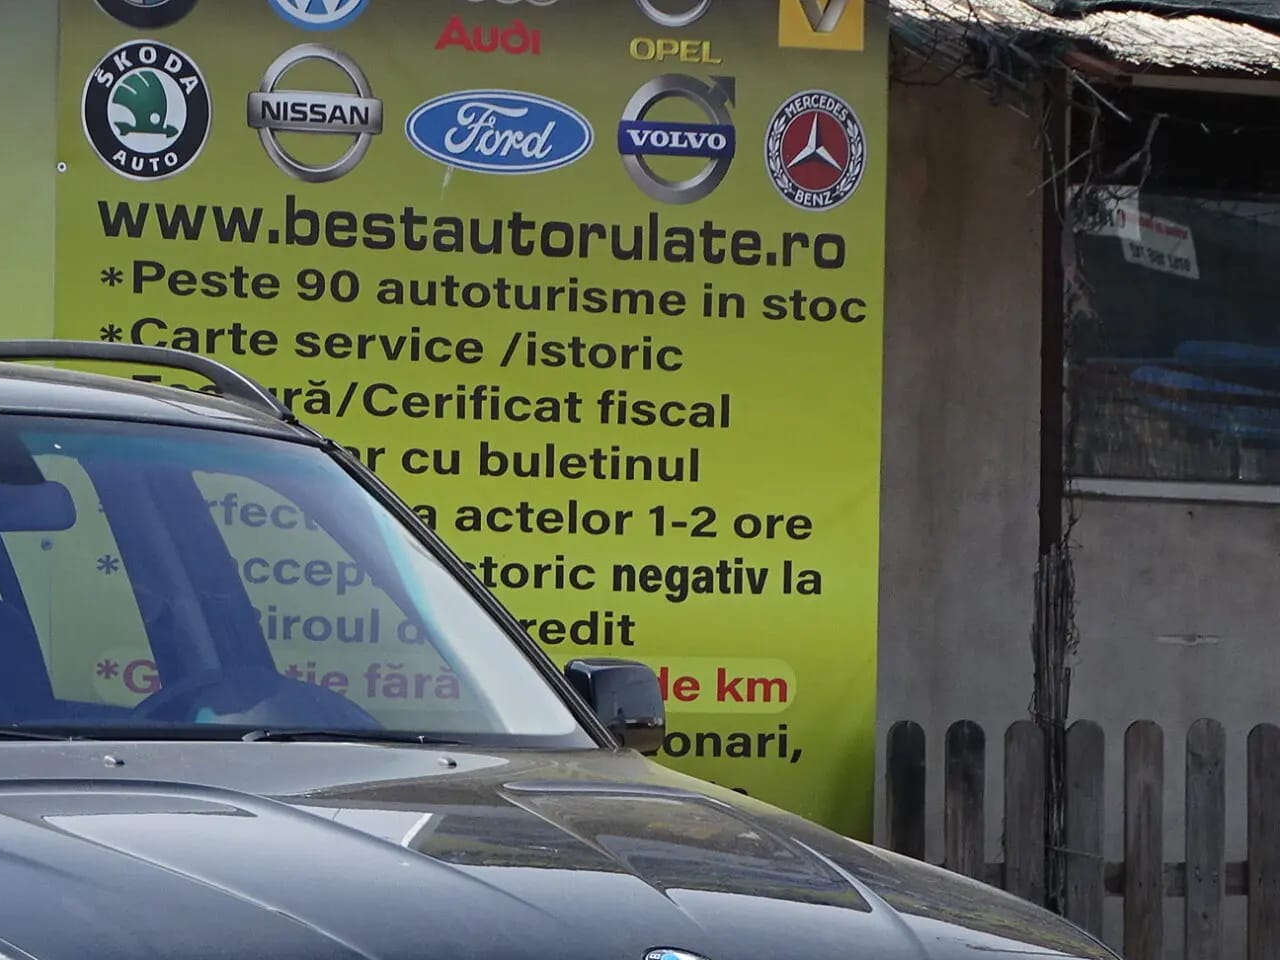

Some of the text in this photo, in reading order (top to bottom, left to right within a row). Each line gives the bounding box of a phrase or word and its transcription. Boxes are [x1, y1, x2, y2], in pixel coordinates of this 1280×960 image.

[434, 15, 542, 56] Audi
[629, 37, 723, 65] OPEL
[261, 100, 369, 126] NISSAN
[783, 94, 850, 123] MERCEDES
[443, 101, 554, 160] Ford
[626, 128, 727, 151] VOLVO
[112, 149, 179, 173] AUTO
[793, 190, 834, 207] BENZ
[97, 194, 846, 270] www.bestautorulate.ro
[296, 268, 360, 302] 90
[377, 274, 687, 316] autoturisme
[703, 283, 746, 319] in
[762, 289, 867, 324] stoc
[294, 327, 483, 363] service
[597, 389, 731, 428] fiscal
[401, 447, 461, 475] cu
[479, 441, 700, 483] buletinul
[455, 501, 633, 536] actelor
[648, 505, 717, 538] 1-2
[733, 512, 813, 540] ore
[613, 557, 768, 603] negativ
[783, 560, 822, 595] la
[363, 663, 460, 699] fără
[717, 667, 788, 703] km
